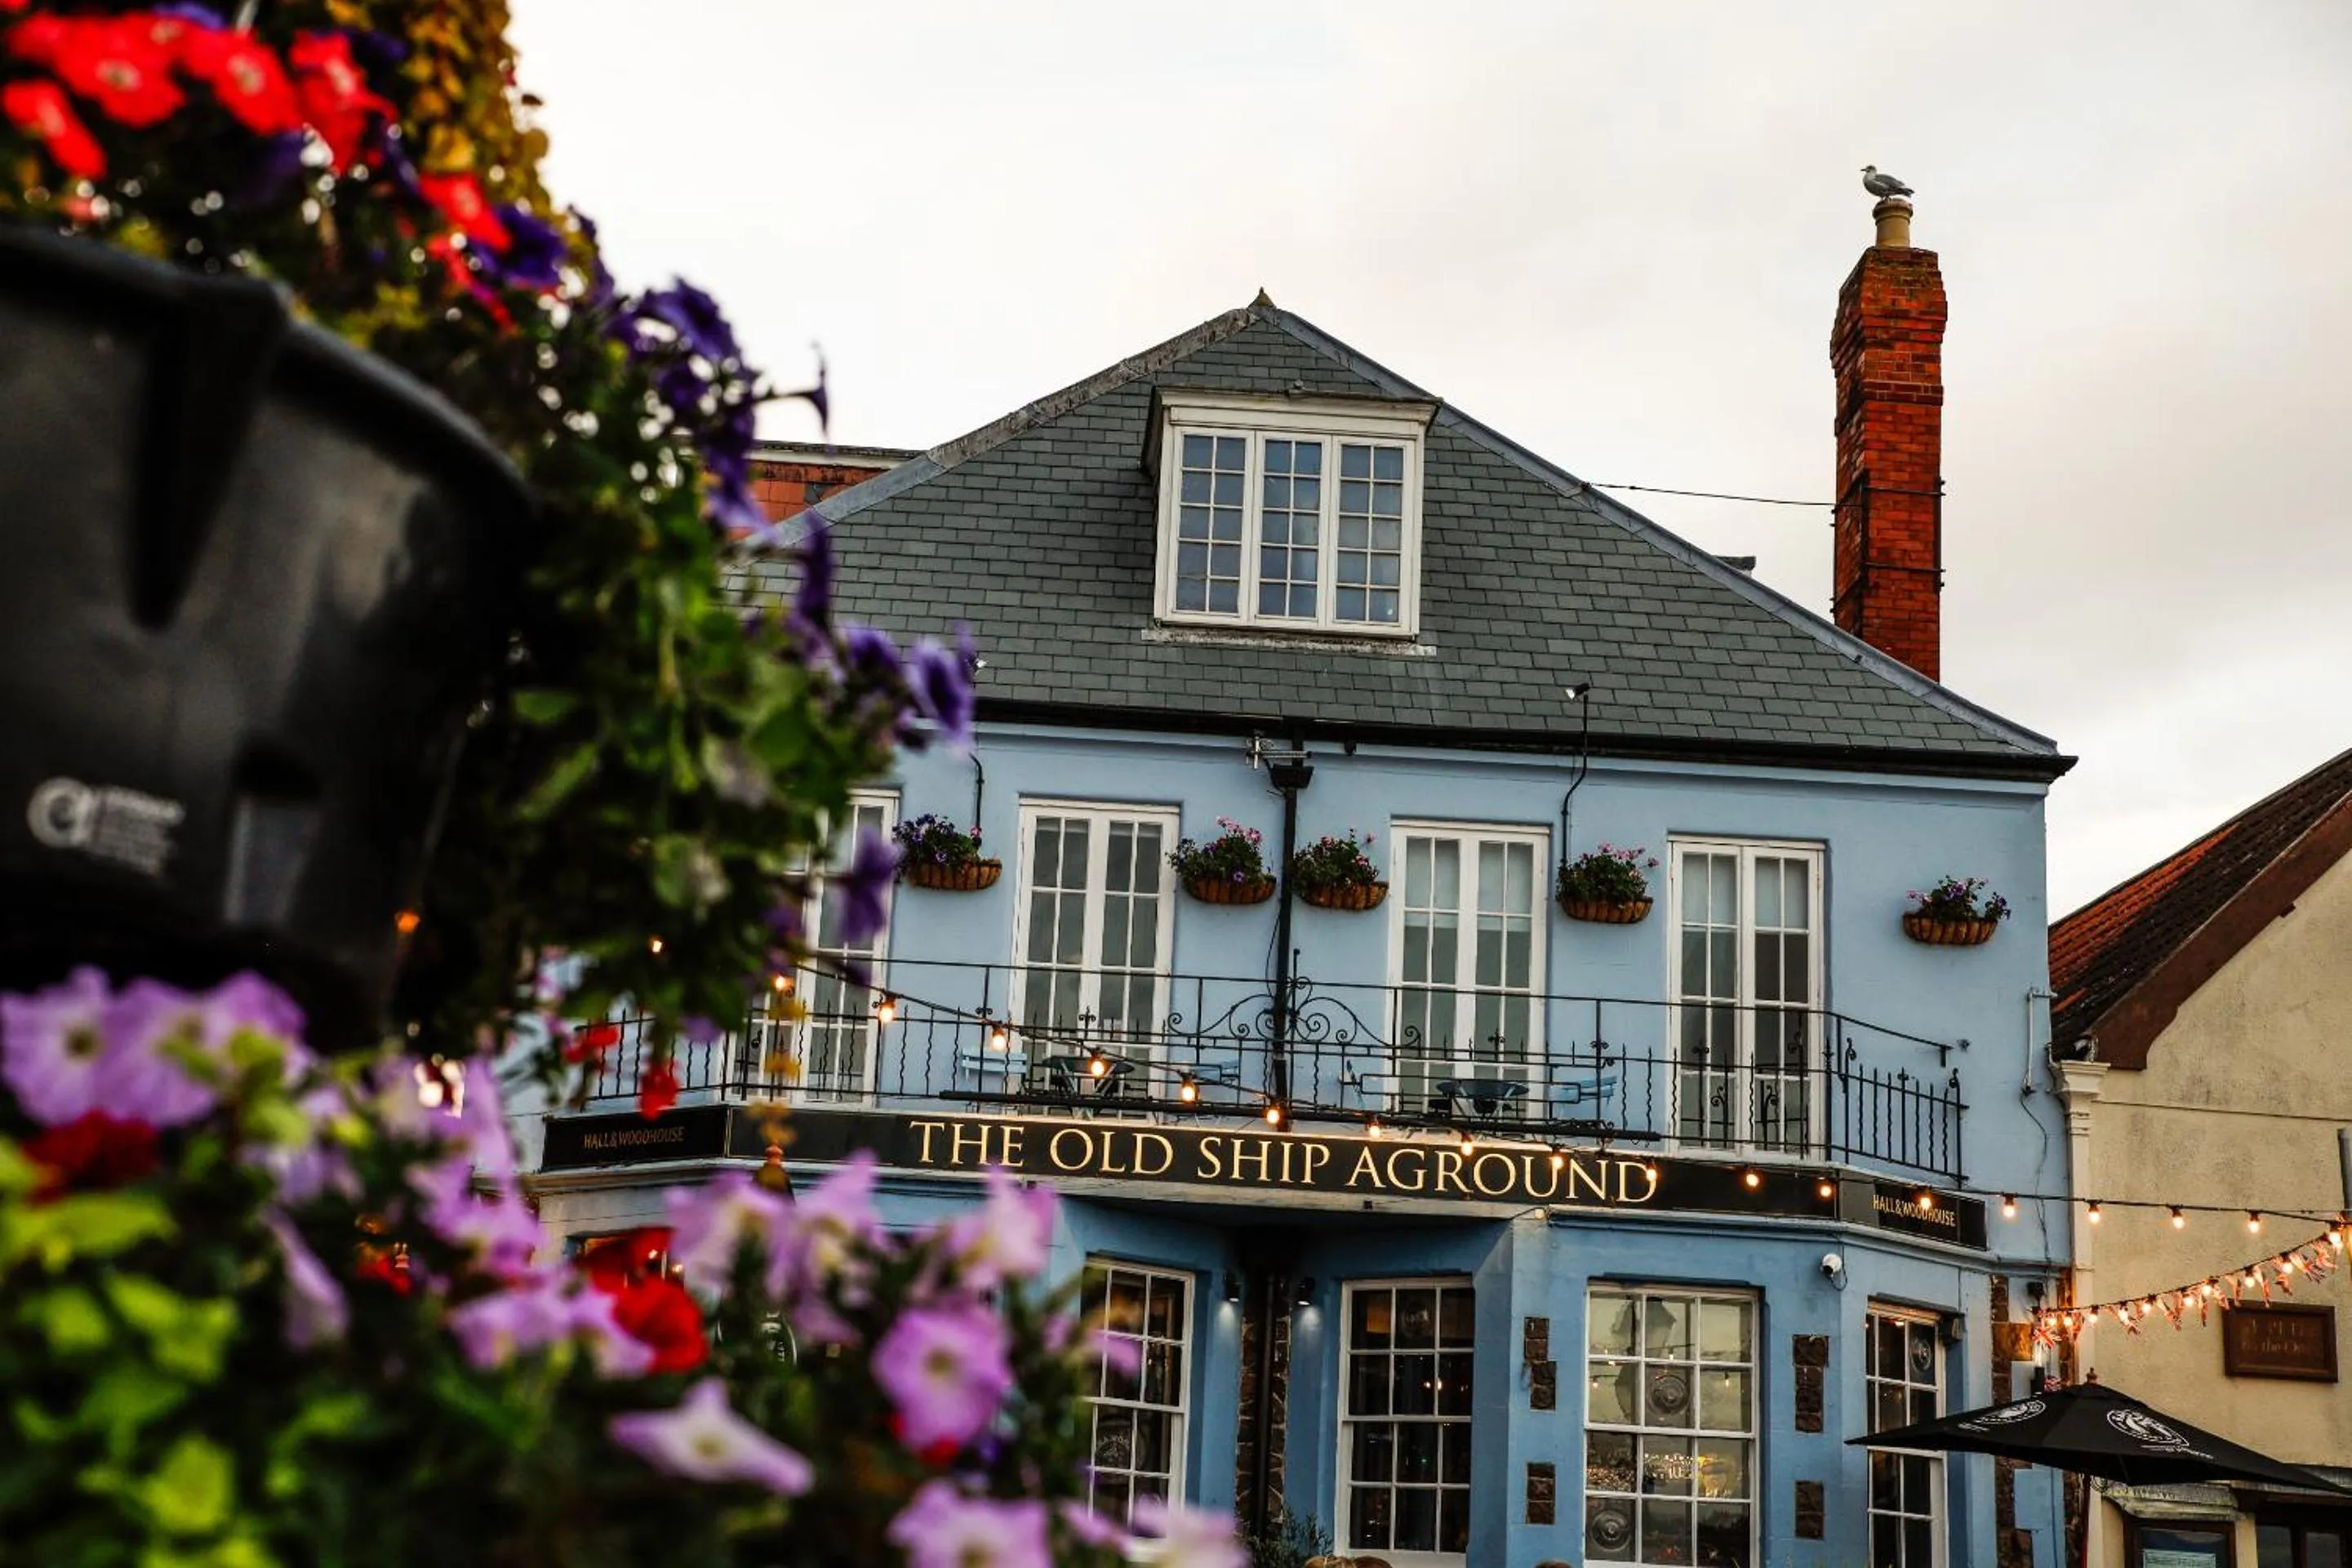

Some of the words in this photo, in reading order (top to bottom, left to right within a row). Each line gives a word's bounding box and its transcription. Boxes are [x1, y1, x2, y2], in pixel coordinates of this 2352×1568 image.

[909, 1120, 1025, 1168] THE
[1049, 1127, 1174, 1175] OLD
[1198, 1136, 1330, 1185] SHIP
[1345, 1146, 1657, 1203] AGROUND
